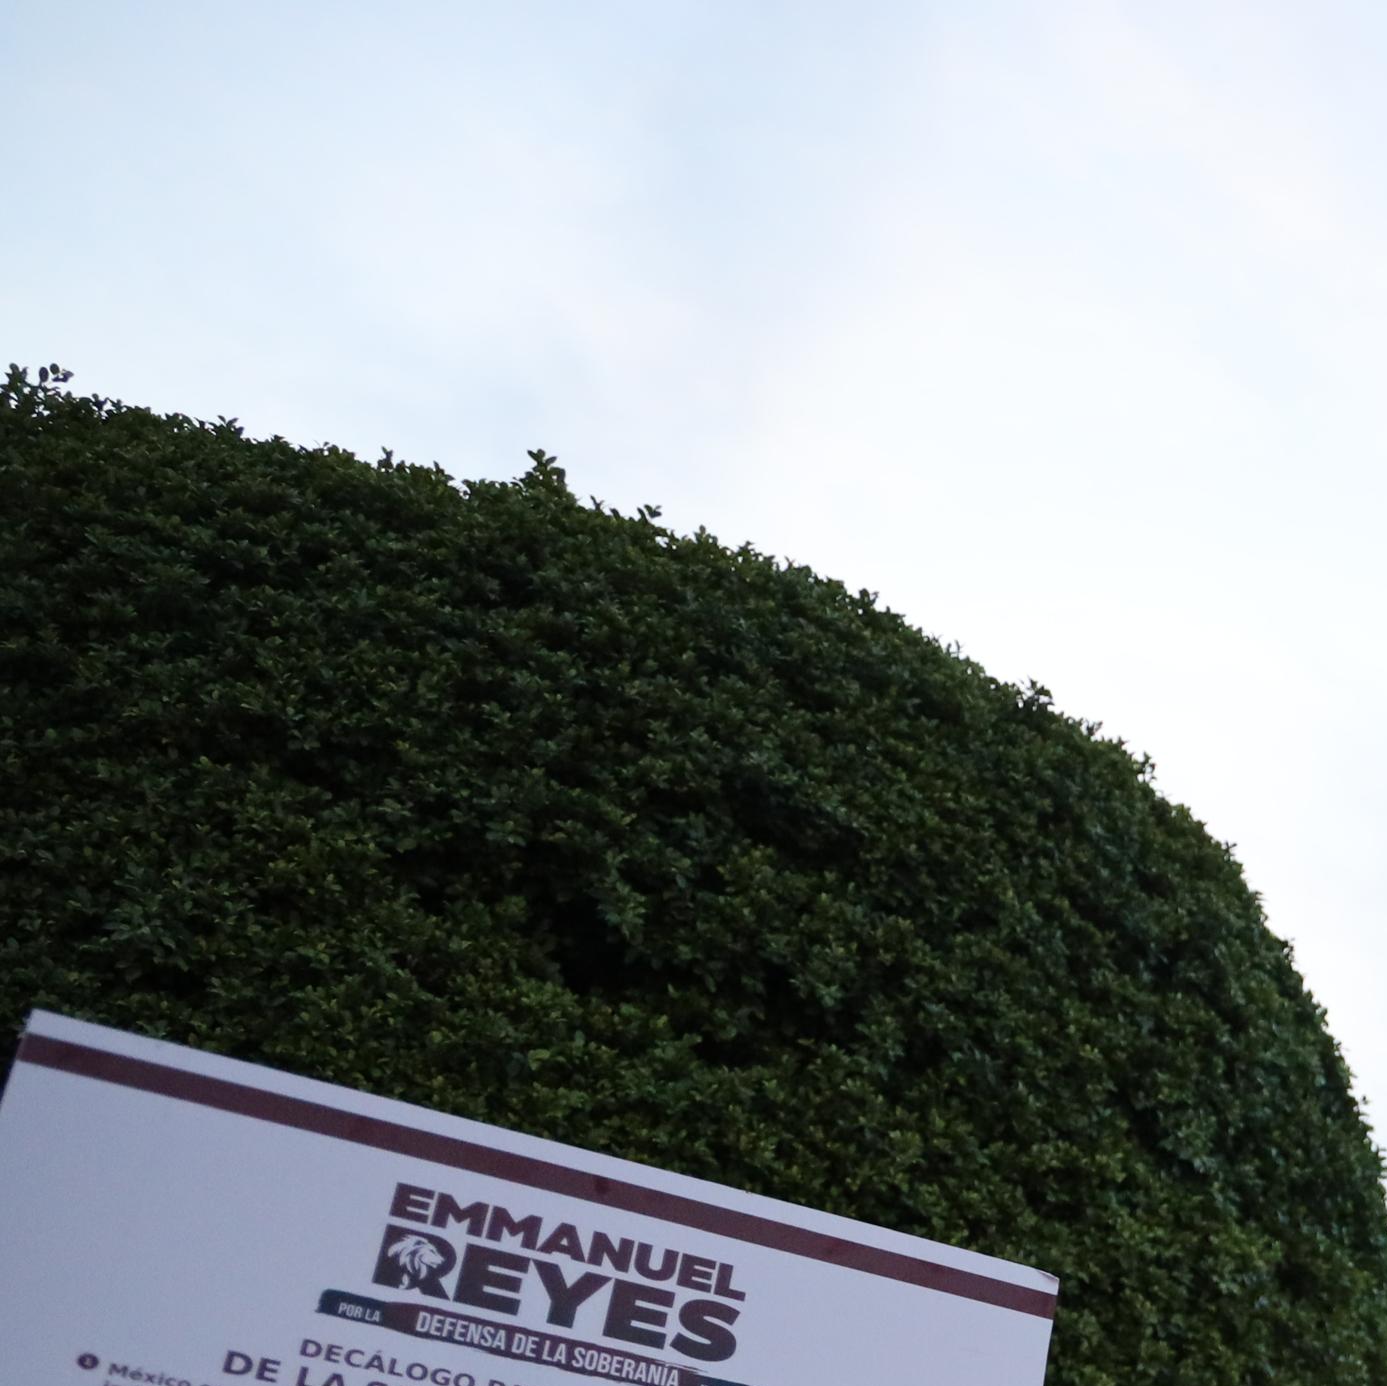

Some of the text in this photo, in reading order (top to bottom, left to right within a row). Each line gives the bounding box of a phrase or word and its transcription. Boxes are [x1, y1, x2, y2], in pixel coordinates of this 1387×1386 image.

[389, 1182, 746, 1302] EMMANUEL
[338, 1301, 362, 1320] POR
[364, 1307, 381, 1323] LA
[415, 1312, 506, 1351] DEFENSA
[512, 1333, 538, 1358] DE
[542, 1339, 567, 1364] LA
[372, 1224, 741, 1361] REYES
[222, 1350, 280, 1382] DE
